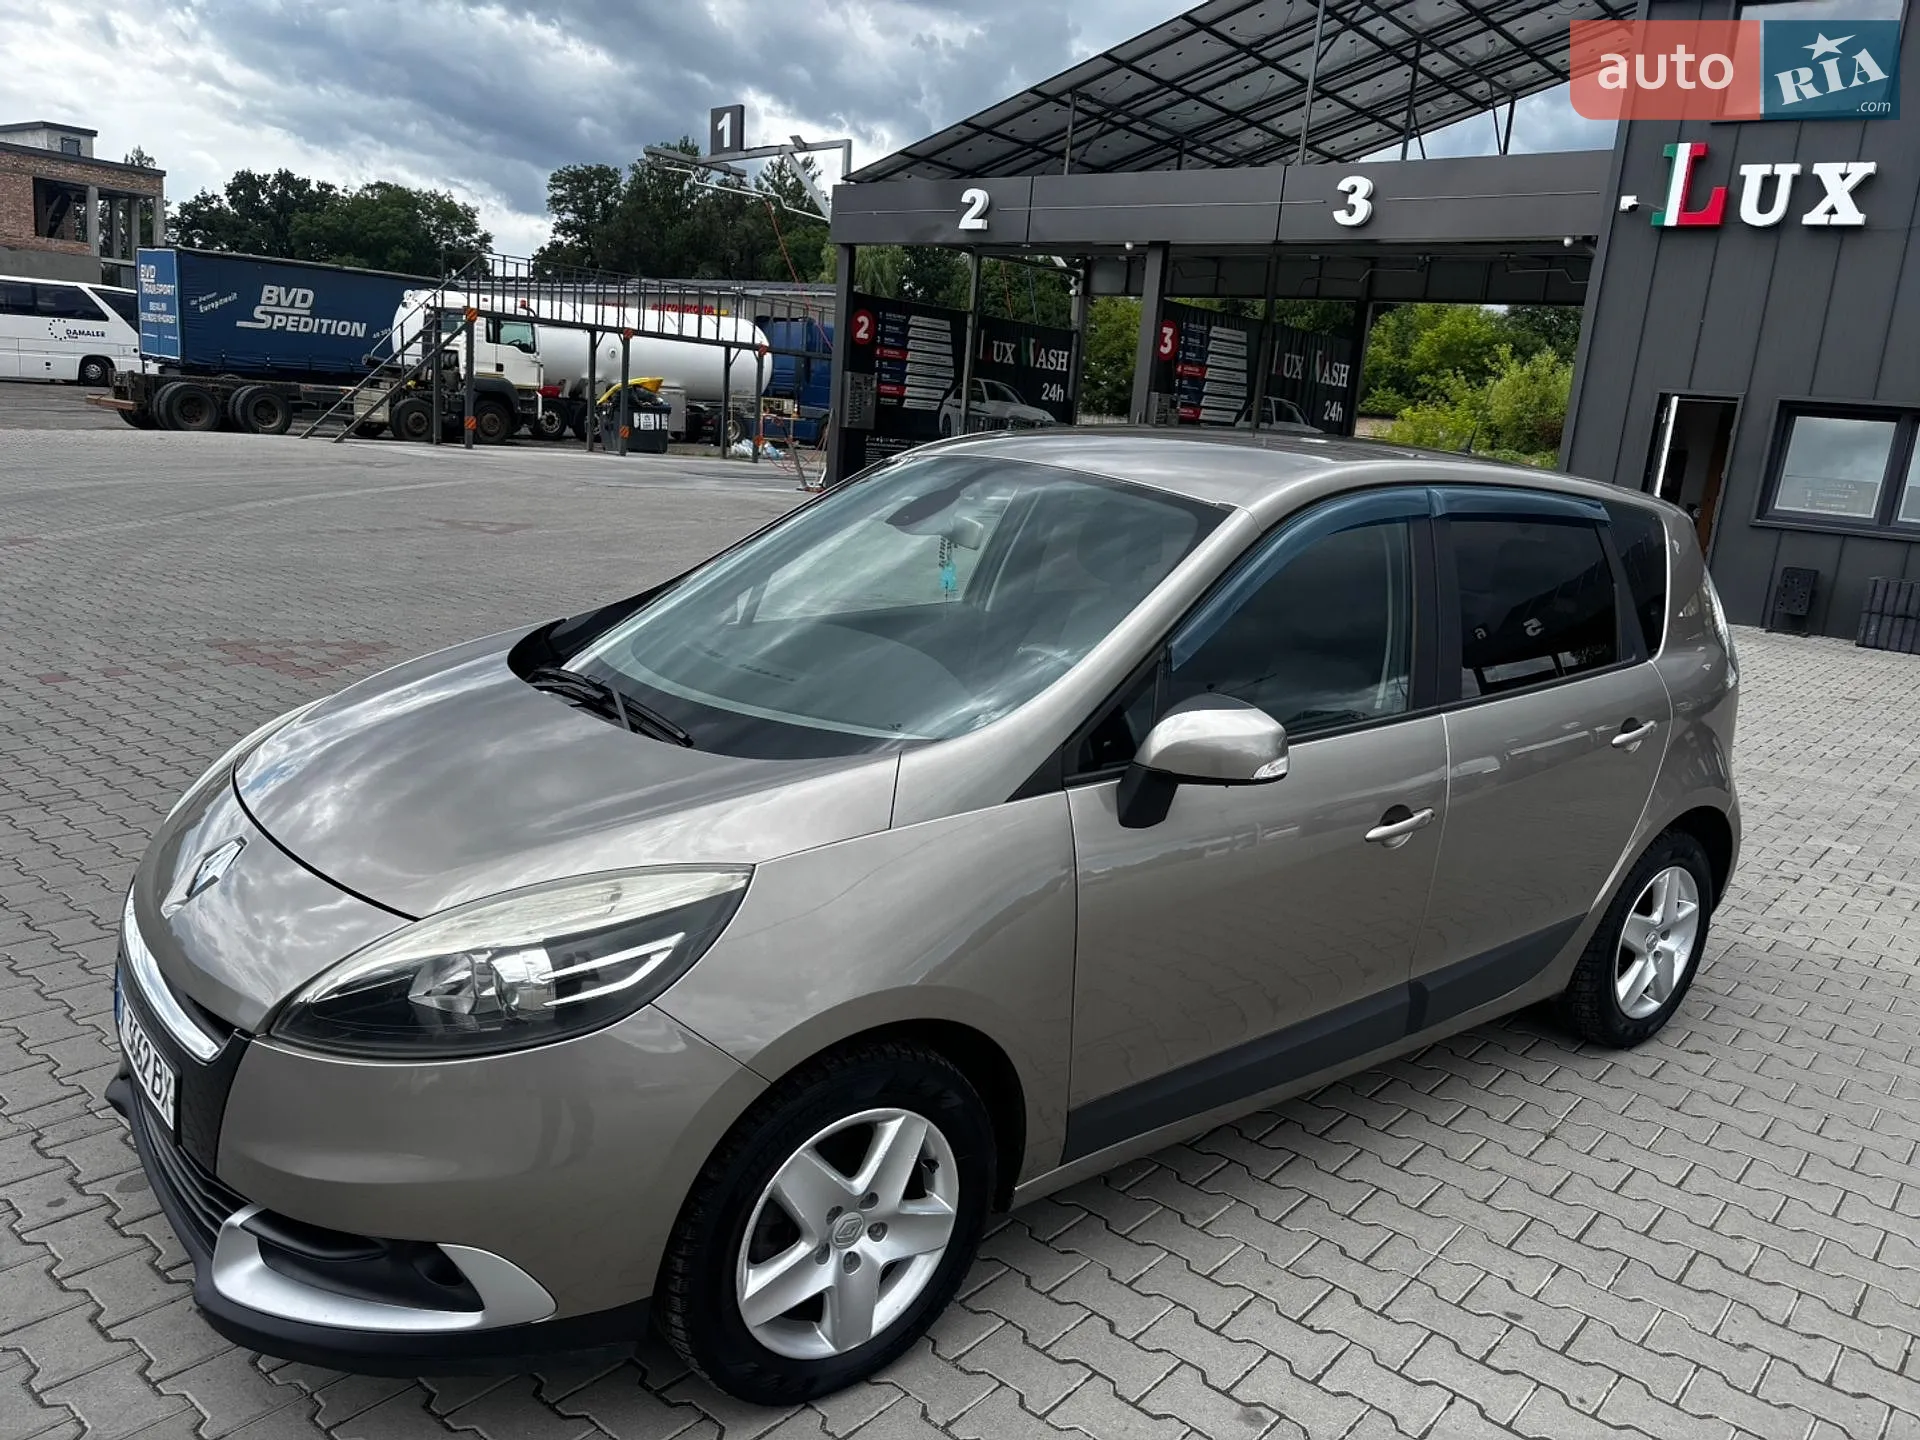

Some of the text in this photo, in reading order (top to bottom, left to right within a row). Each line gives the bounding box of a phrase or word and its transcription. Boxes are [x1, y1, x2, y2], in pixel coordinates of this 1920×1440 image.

[717, 112, 732, 148] 1
[1651, 142, 1878, 228] LUX
[958, 188, 990, 230] 2
[1333, 175, 1374, 227] 3
[260, 284, 315, 308] BVD
[236, 305, 367, 338] SPEDITION
[856, 315, 870, 340] 2
[1160, 327, 1174, 354] 3
[1041, 382, 1064, 402] 24h
[1323, 400, 1343, 422] 24h
